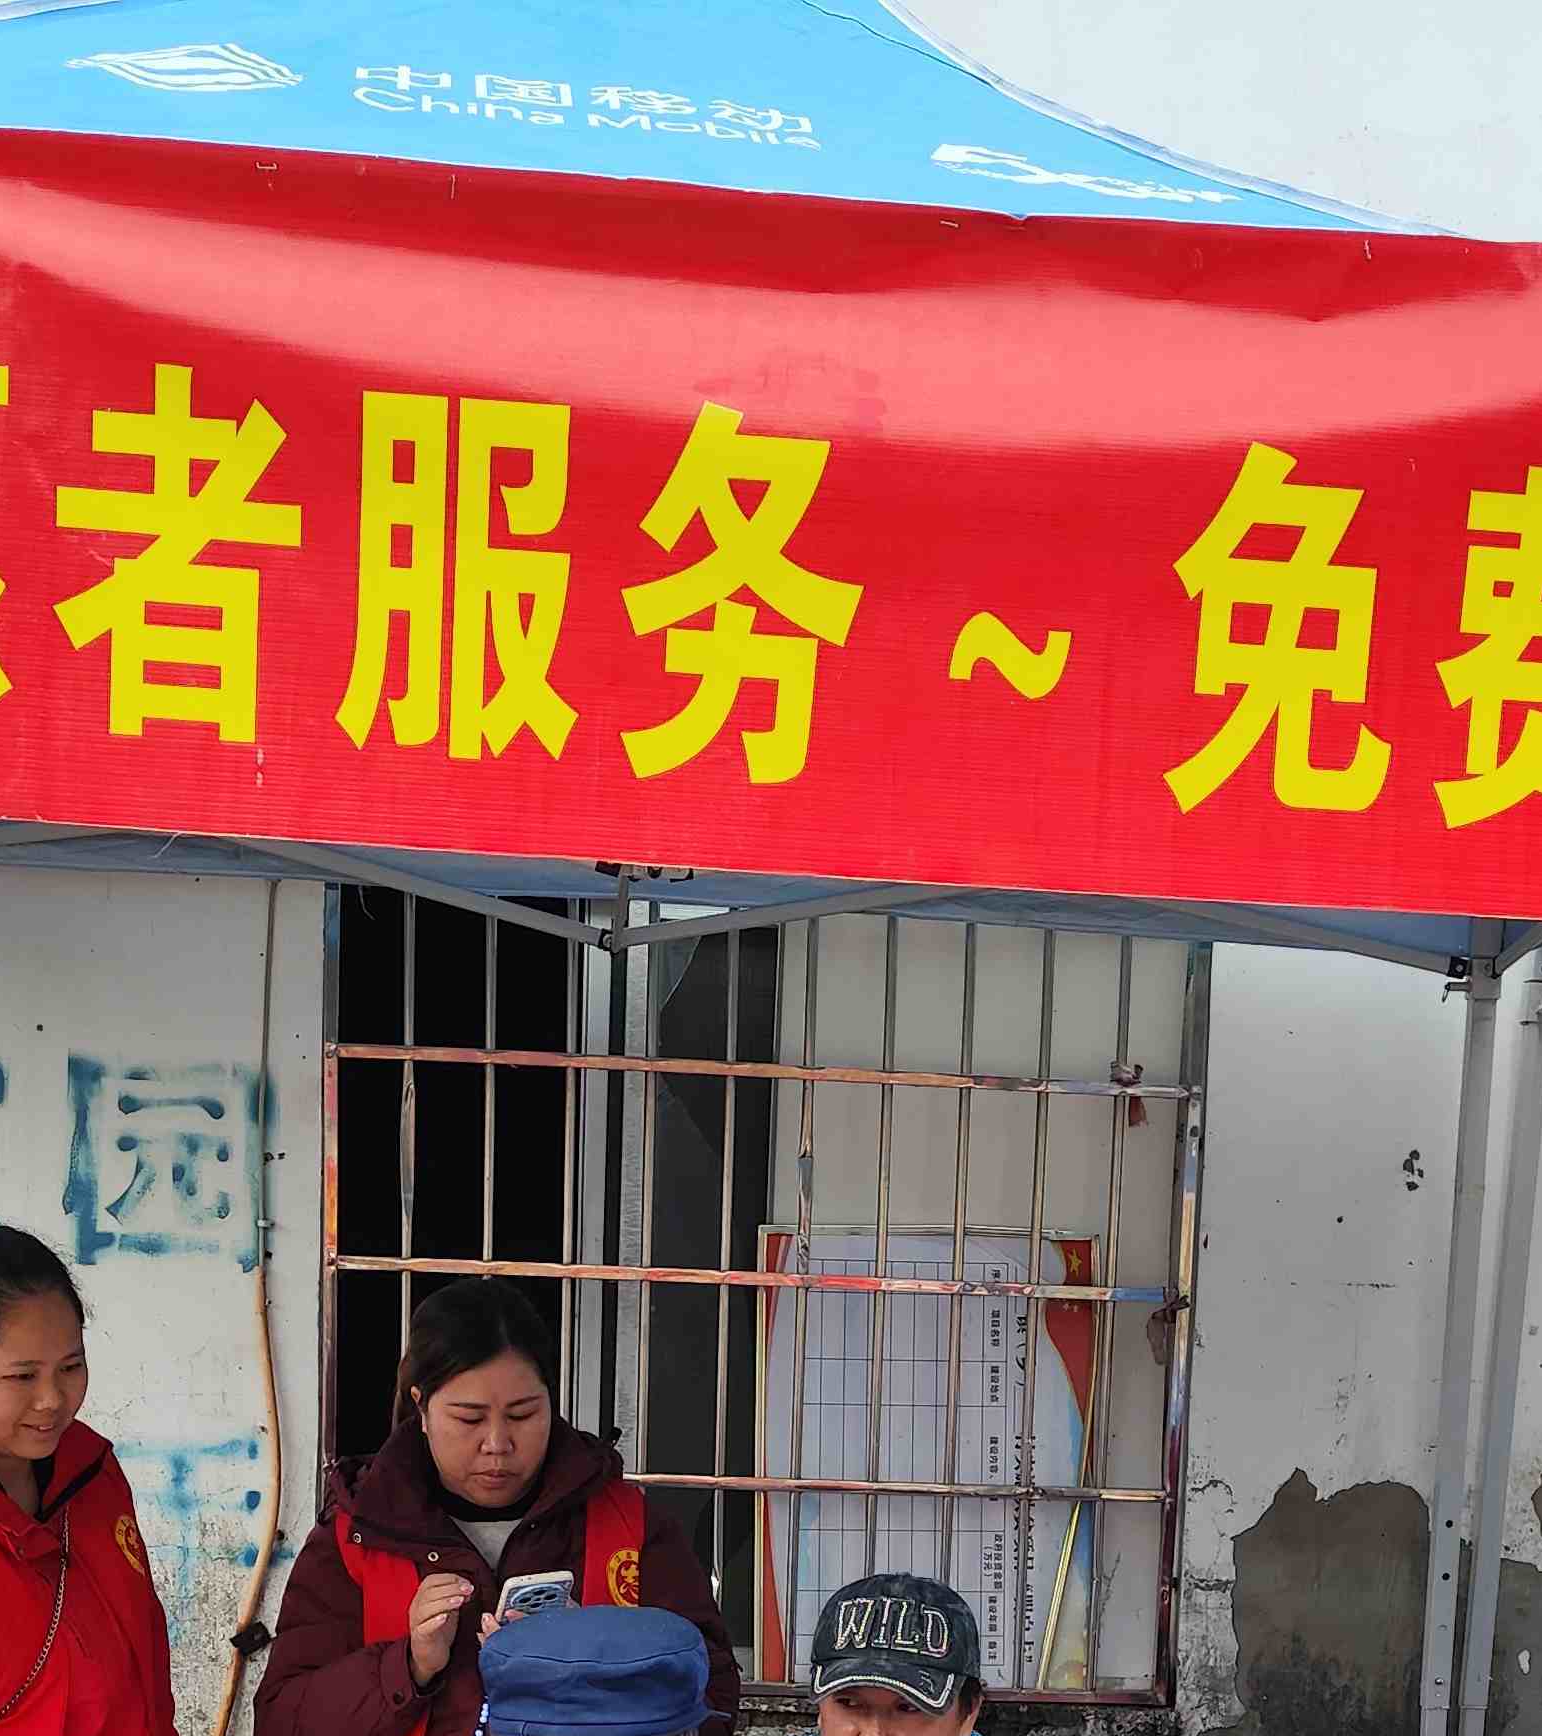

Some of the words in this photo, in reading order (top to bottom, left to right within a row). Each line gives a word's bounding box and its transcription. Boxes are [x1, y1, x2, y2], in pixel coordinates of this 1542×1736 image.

[351, 86, 565, 126] China
[585, 112, 823, 152] Mobile
[355, 63, 812, 135] 中国移动
[833, 1597, 951, 1657] WILD
